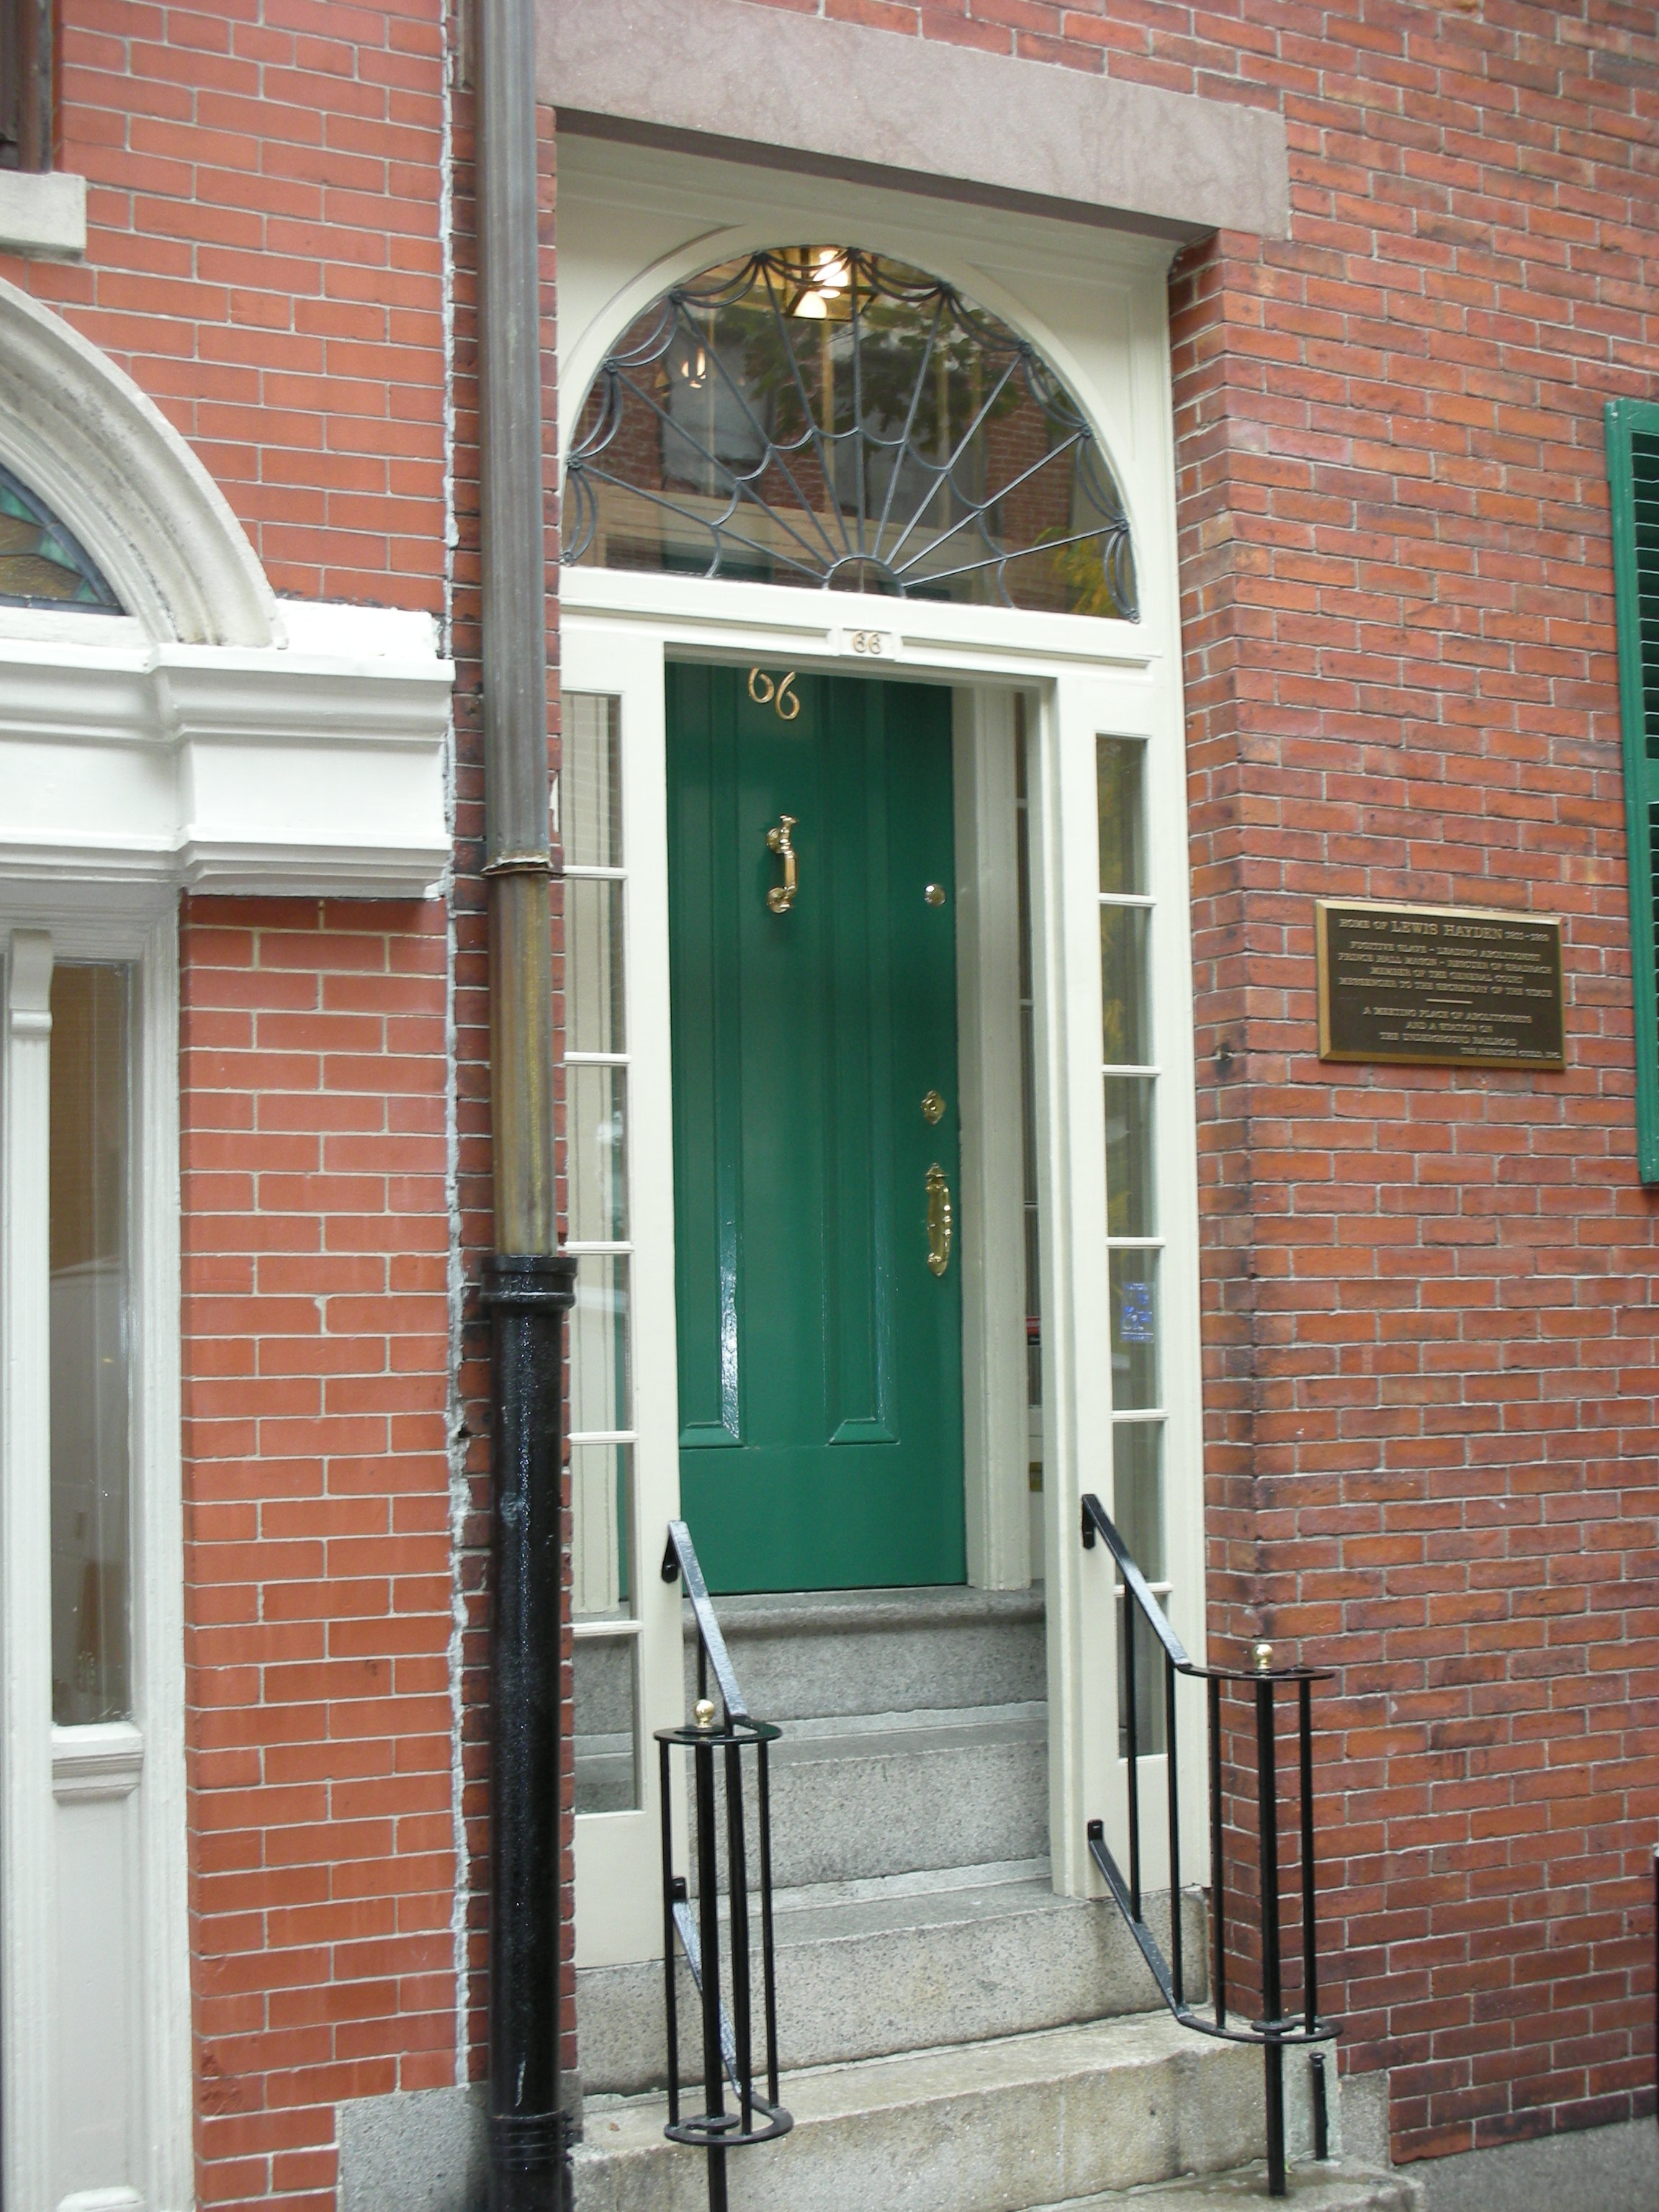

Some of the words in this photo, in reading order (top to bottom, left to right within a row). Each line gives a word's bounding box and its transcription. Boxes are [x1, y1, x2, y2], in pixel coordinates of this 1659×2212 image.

[853, 631, 881, 654] 66
[747, 667, 800, 720] 66
[1338, 918, 1370, 929] HOME
[1373, 920, 1388, 930] OF
[1390, 920, 1439, 935] LEWIS
[1442, 924, 1503, 940] HAYDEN
[1349, 941, 1395, 952] FUGITIVE
[1396, 944, 1427, 954] SLAVE
[1436, 946, 1478, 957] LEADING
[1480, 950, 1541, 961] ABOLITIONIST
[1338, 952, 1374, 963] PRINCE
[1375, 955, 1403, 964] HALL
[1404, 956, 1437, 966] MASON
[1447, 959, 1488, 970] RESCUER
[1490, 962, 1503, 971] OF
[1370, 966, 1411, 976] MEMBER
[1412, 969, 1426, 978] OF
[1428, 971, 1447, 979] THE
[1449, 971, 1493, 982] GENERAL
[1494, 974, 1524, 984] COURT
[1338, 977, 1397, 988] MESSENGER
[1399, 980, 1412, 989] TO
[1413, 981, 1434, 990] THE
[1435, 982, 1488, 994] SECRETARY
[1490, 986, 1503, 994] OF
[1505, 987, 1524, 996] THE
[1525, 989, 1553, 998] STATE
[1362, 1007, 1372, 1015] A
[1373, 1007, 1417, 1017] MEETING
[1418, 1010, 1449, 1019] PLACE
[1450, 1011, 1463, 1020] OF
[1465, 1012, 1532, 1024] ABOLITIONISTS
[1406, 1021, 1427, 1030] AND
[1438, 1022, 1476, 1032] STATION
[1479, 1025, 1493, 1033] ON
[1378, 1032, 1400, 1040] THE
[1402, 1033, 1470, 1044] UNDERGROUND
[1472, 1037, 1518, 1046] RAILROAD
[1478, 1048, 1517, 1057] HERITAGE
